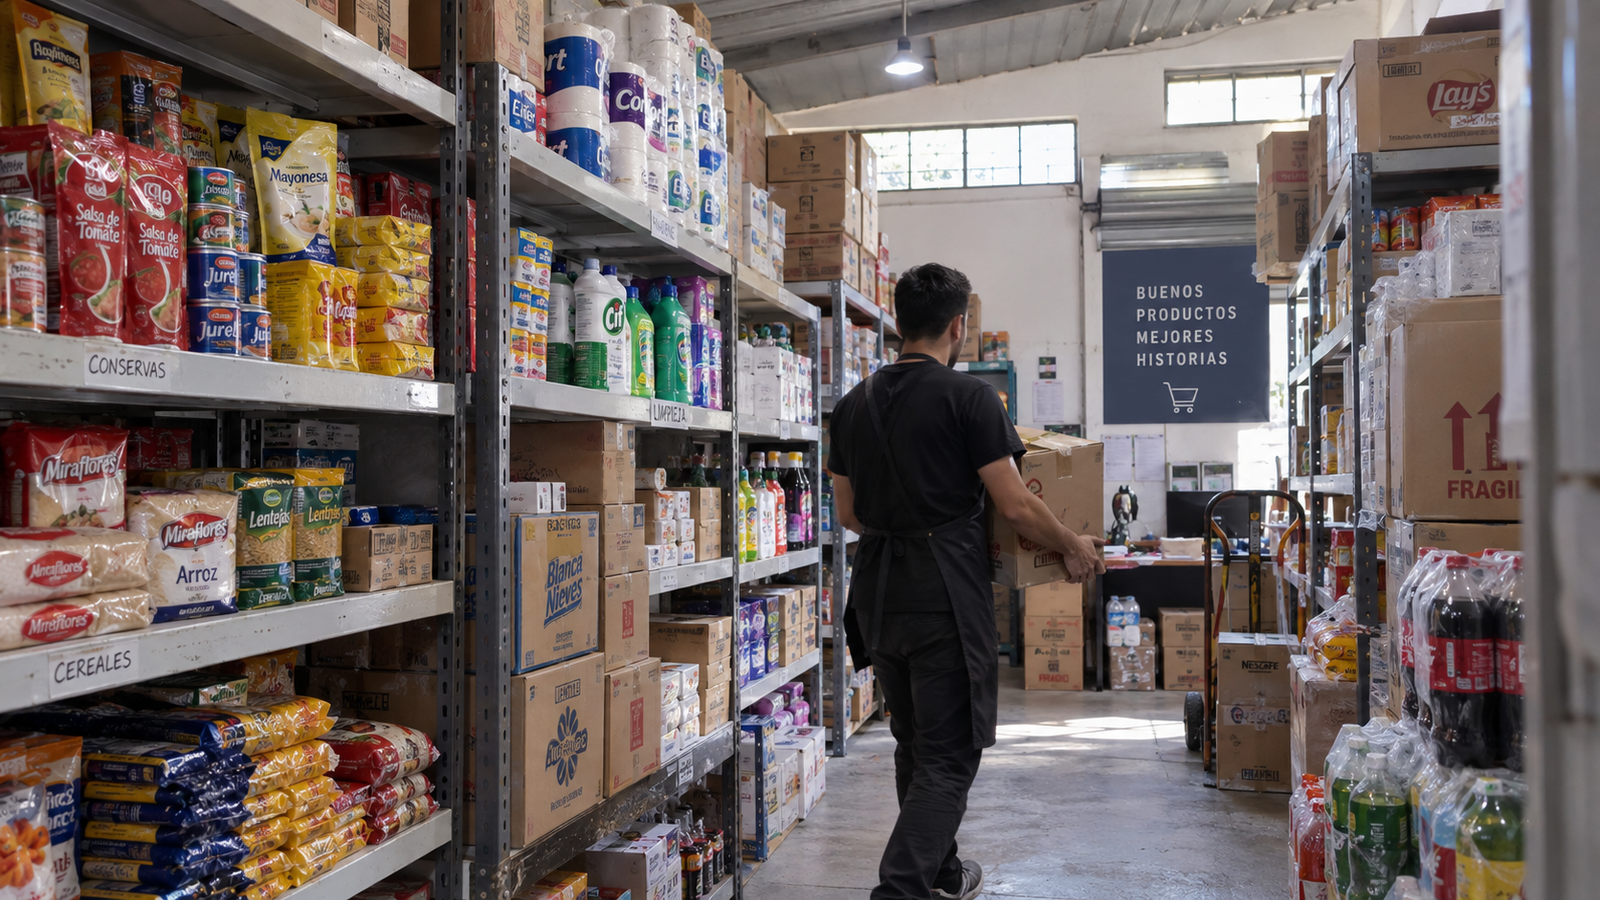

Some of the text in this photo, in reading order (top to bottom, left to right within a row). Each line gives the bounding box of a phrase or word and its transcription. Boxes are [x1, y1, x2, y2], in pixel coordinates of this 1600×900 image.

[1432, 81, 1492, 111] Lay's
[270, 167, 328, 187] Mayonesa
[75, 203, 120, 228] Salsa de
[75, 221, 120, 243] Tomate
[139, 222, 179, 244] Salsa de
[1136, 284, 1203, 300] BUENOS
[605, 302, 625, 332] Cif
[1136, 305, 1237, 322] PRODUCTOS
[1136, 329, 1214, 344] MEJORES
[88, 354, 166, 379] CONSERVAS
[1136, 351, 1228, 367] HISTORIAS
[43, 452, 118, 483] Miraflores
[249, 507, 290, 529] Lentejas
[163, 518, 228, 547] Miraflores
[176, 565, 218, 584] Arroz
[546, 553, 583, 590] Blanca
[545, 577, 583, 618] Nieves
[53, 650, 132, 684] CEREALES
